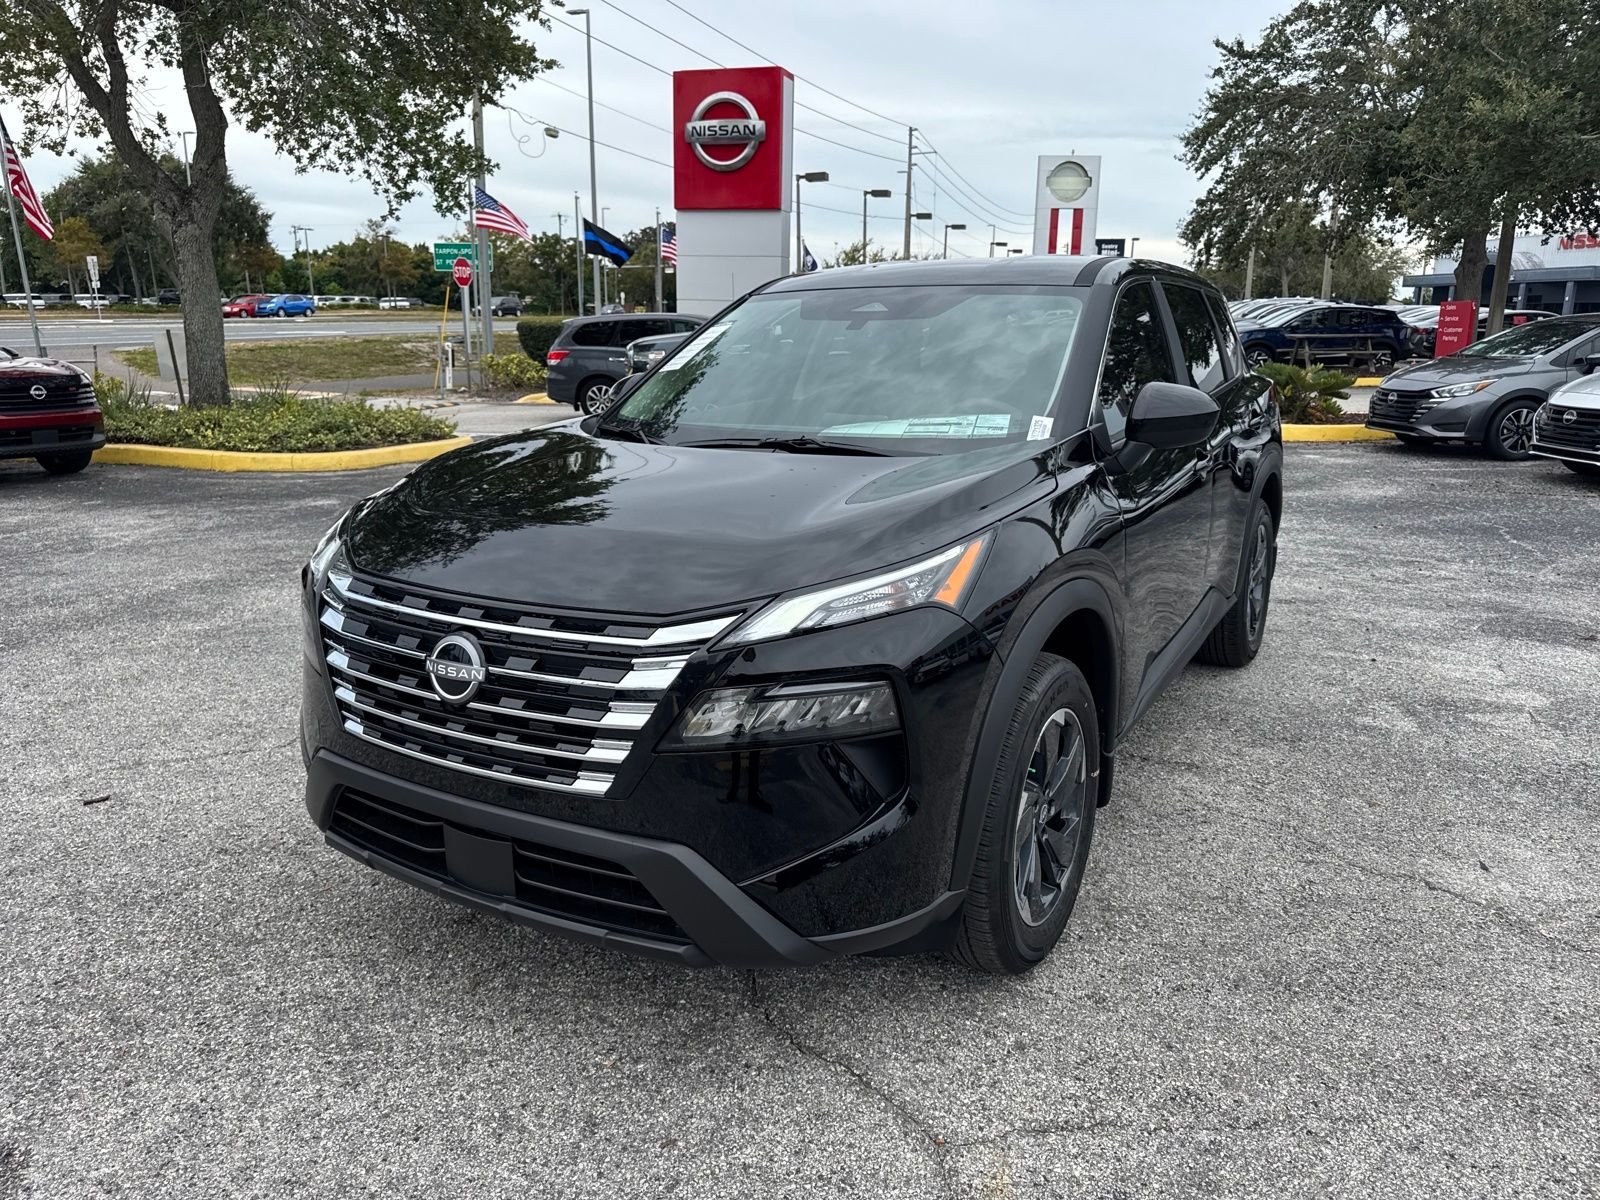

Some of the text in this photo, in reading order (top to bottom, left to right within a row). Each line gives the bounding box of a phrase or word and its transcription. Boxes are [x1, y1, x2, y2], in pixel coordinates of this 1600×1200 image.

[691, 124, 756, 137] NISSAN
[1559, 234, 1600, 249] NISS
[455, 266, 471, 278] STOP
[1442, 335, 1458, 343] Parking
[426, 660, 483, 680] NISSAN
